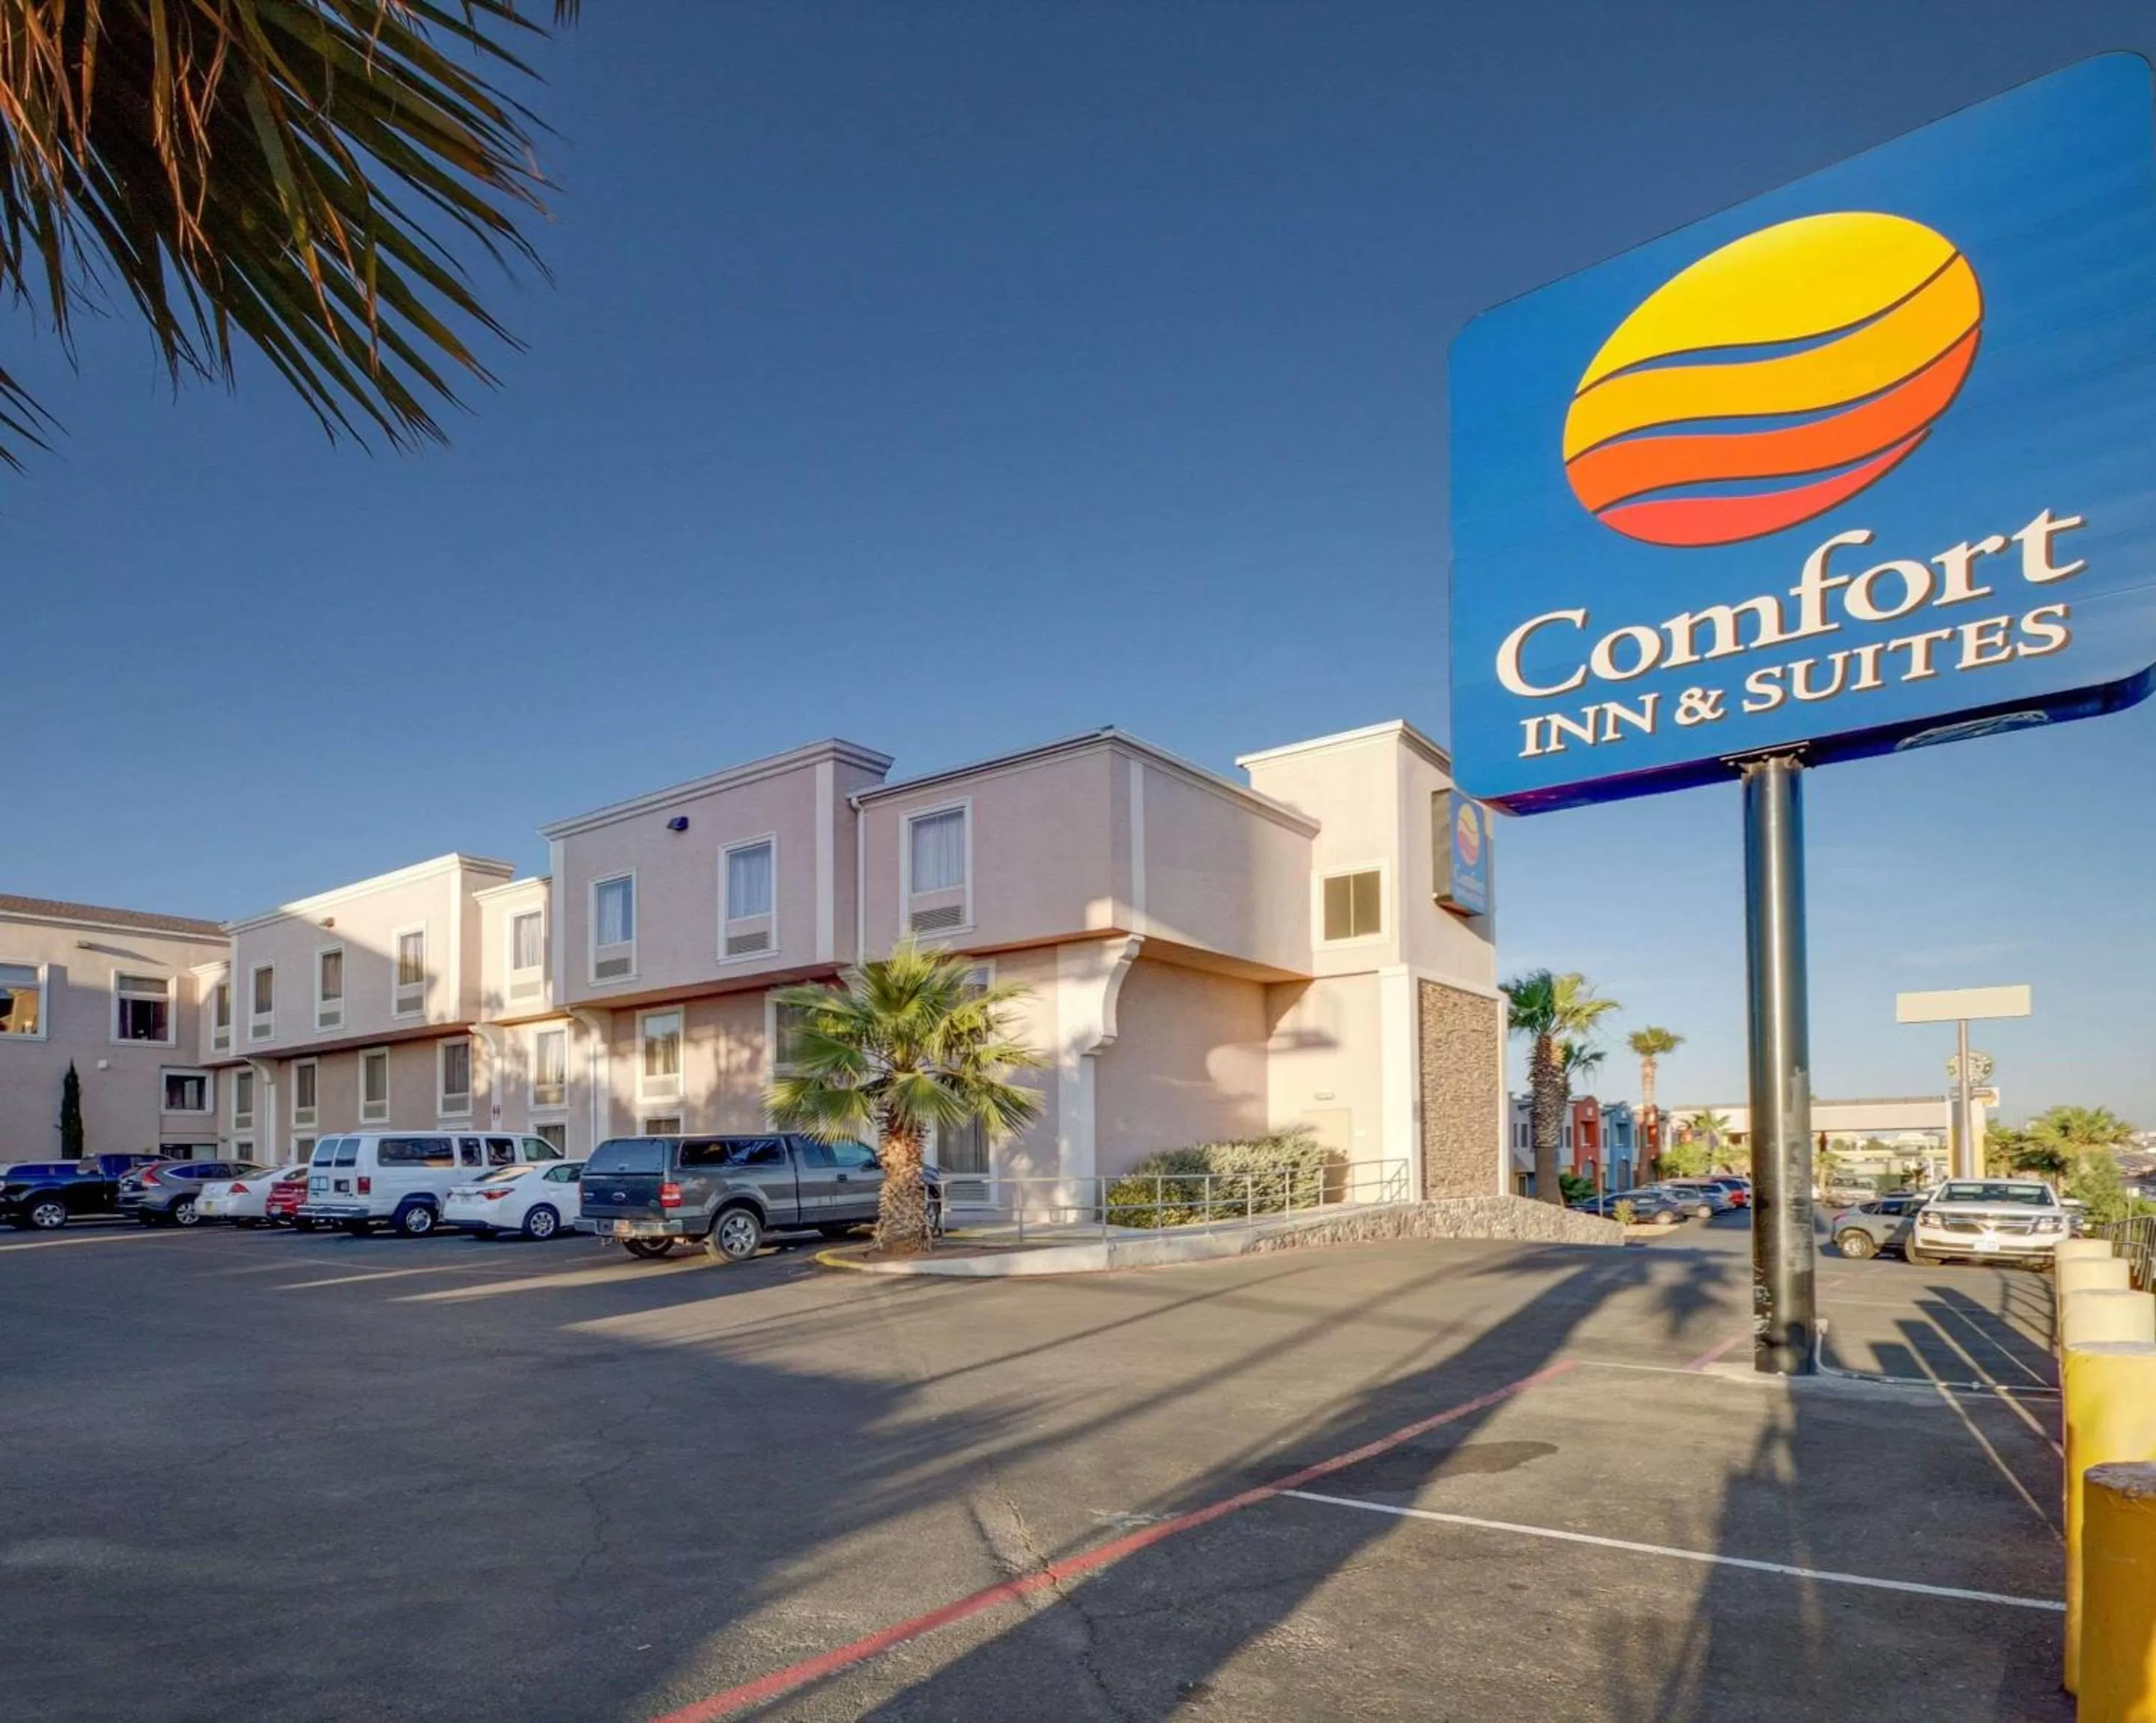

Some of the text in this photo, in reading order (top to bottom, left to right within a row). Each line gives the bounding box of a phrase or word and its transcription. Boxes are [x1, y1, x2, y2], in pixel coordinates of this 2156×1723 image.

[1496, 508, 2086, 698] Comfort
[1518, 603, 2071, 759] INN & SUITES
